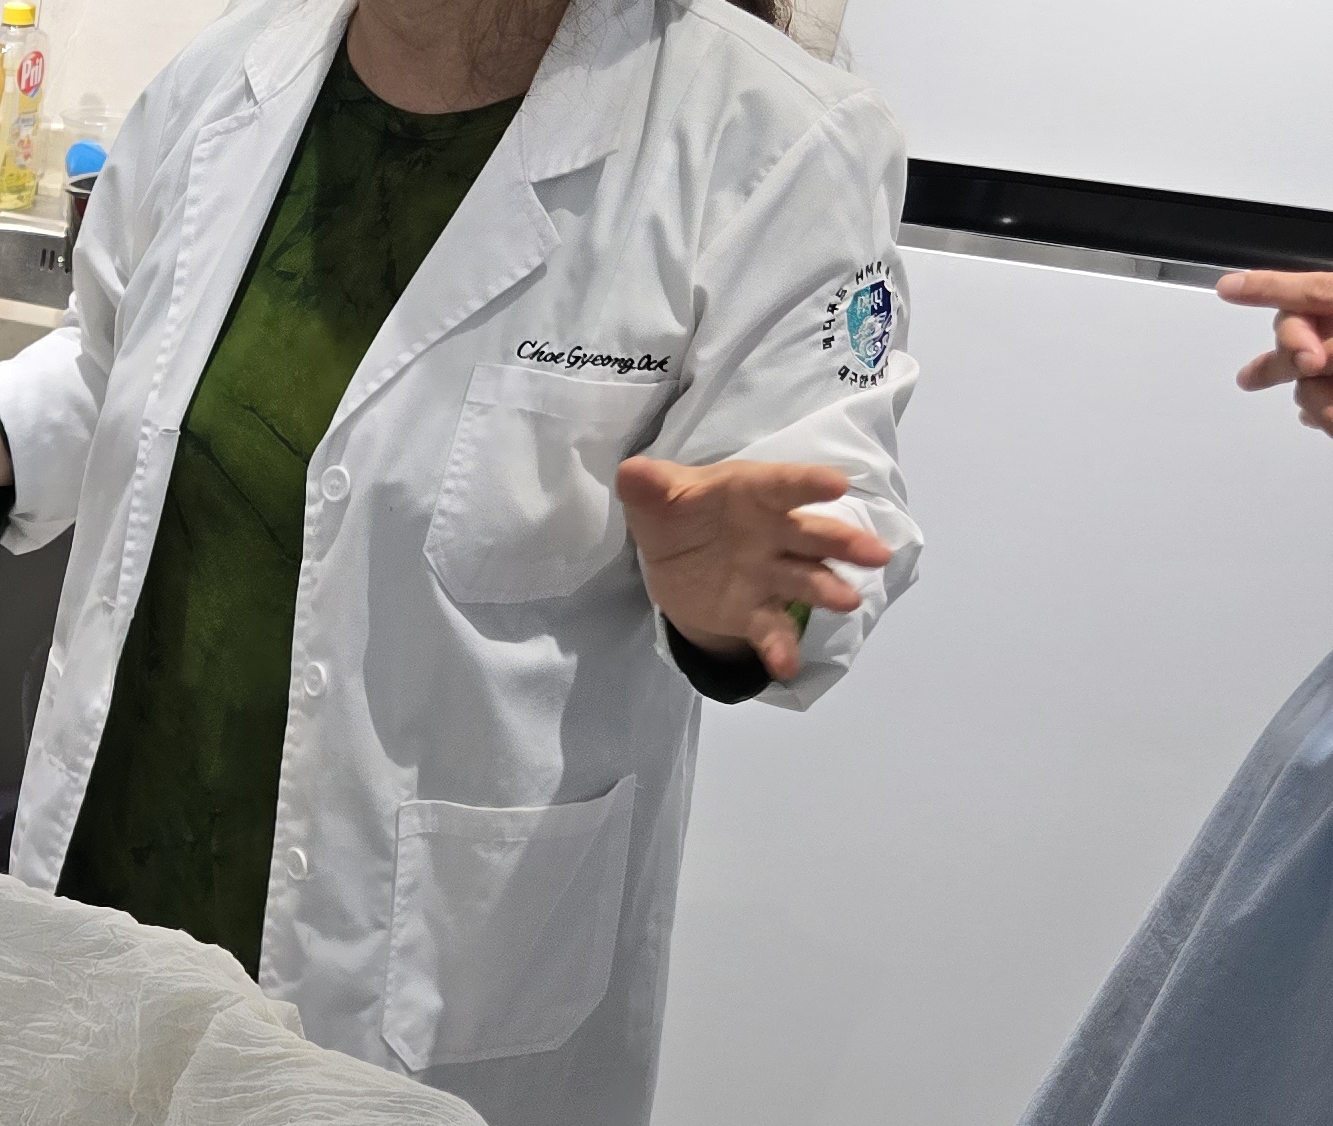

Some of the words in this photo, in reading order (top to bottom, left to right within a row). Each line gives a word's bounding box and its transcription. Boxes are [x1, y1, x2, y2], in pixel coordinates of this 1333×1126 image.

[21, 57, 42, 91] Pril
[516, 340, 565, 364] Choe
[565, 346, 635, 375] Gyeong
